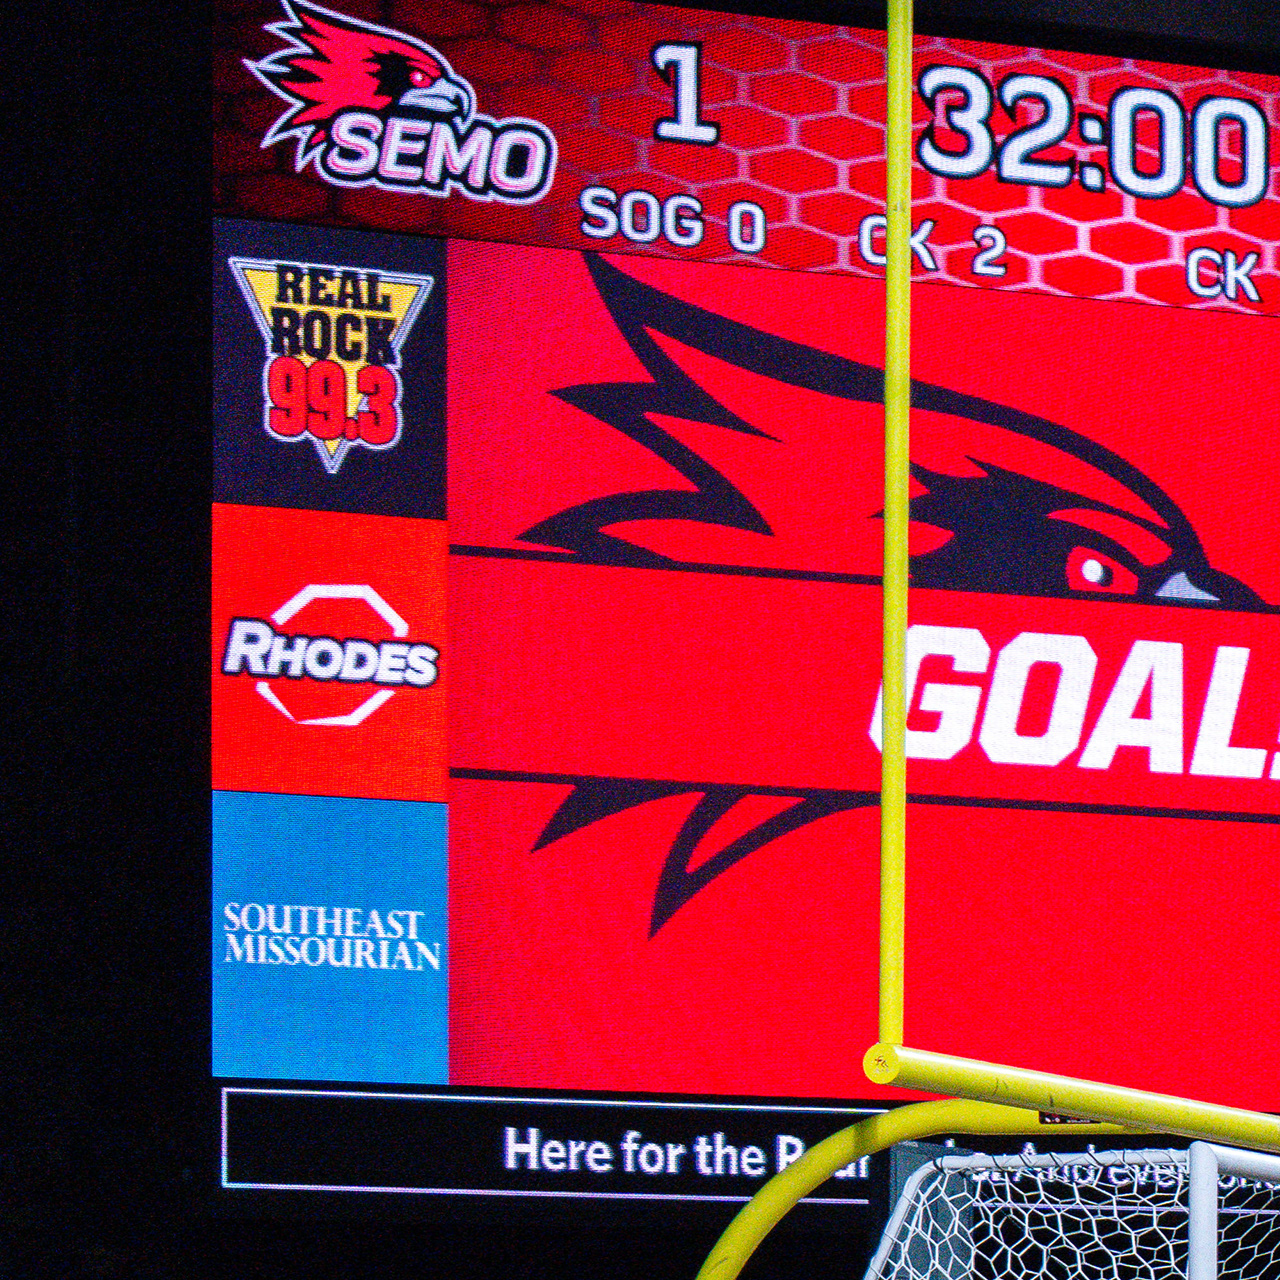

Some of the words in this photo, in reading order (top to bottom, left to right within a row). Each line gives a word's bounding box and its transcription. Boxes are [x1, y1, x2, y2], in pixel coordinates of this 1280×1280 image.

[652, 42, 719, 144] 1
[327, 111, 554, 198] SEMO
[918, 64, 1269, 208] 32:00
[580, 187, 702, 246] SOG
[728, 202, 766, 253] 0
[973, 224, 1006, 276] 2
[1187, 248, 1261, 302] CK
[276, 265, 392, 313] REAL
[271, 307, 399, 366] ROCK
[266, 356, 400, 445] 99.3
[222, 617, 440, 688] RHODES
[224, 903, 425, 940] SOUTHEAST
[224, 934, 440, 971] MISSOURIAN
[504, 1127, 612, 1173] Here
[621, 1131, 686, 1175] for
[695, 1131, 766, 1177] the
